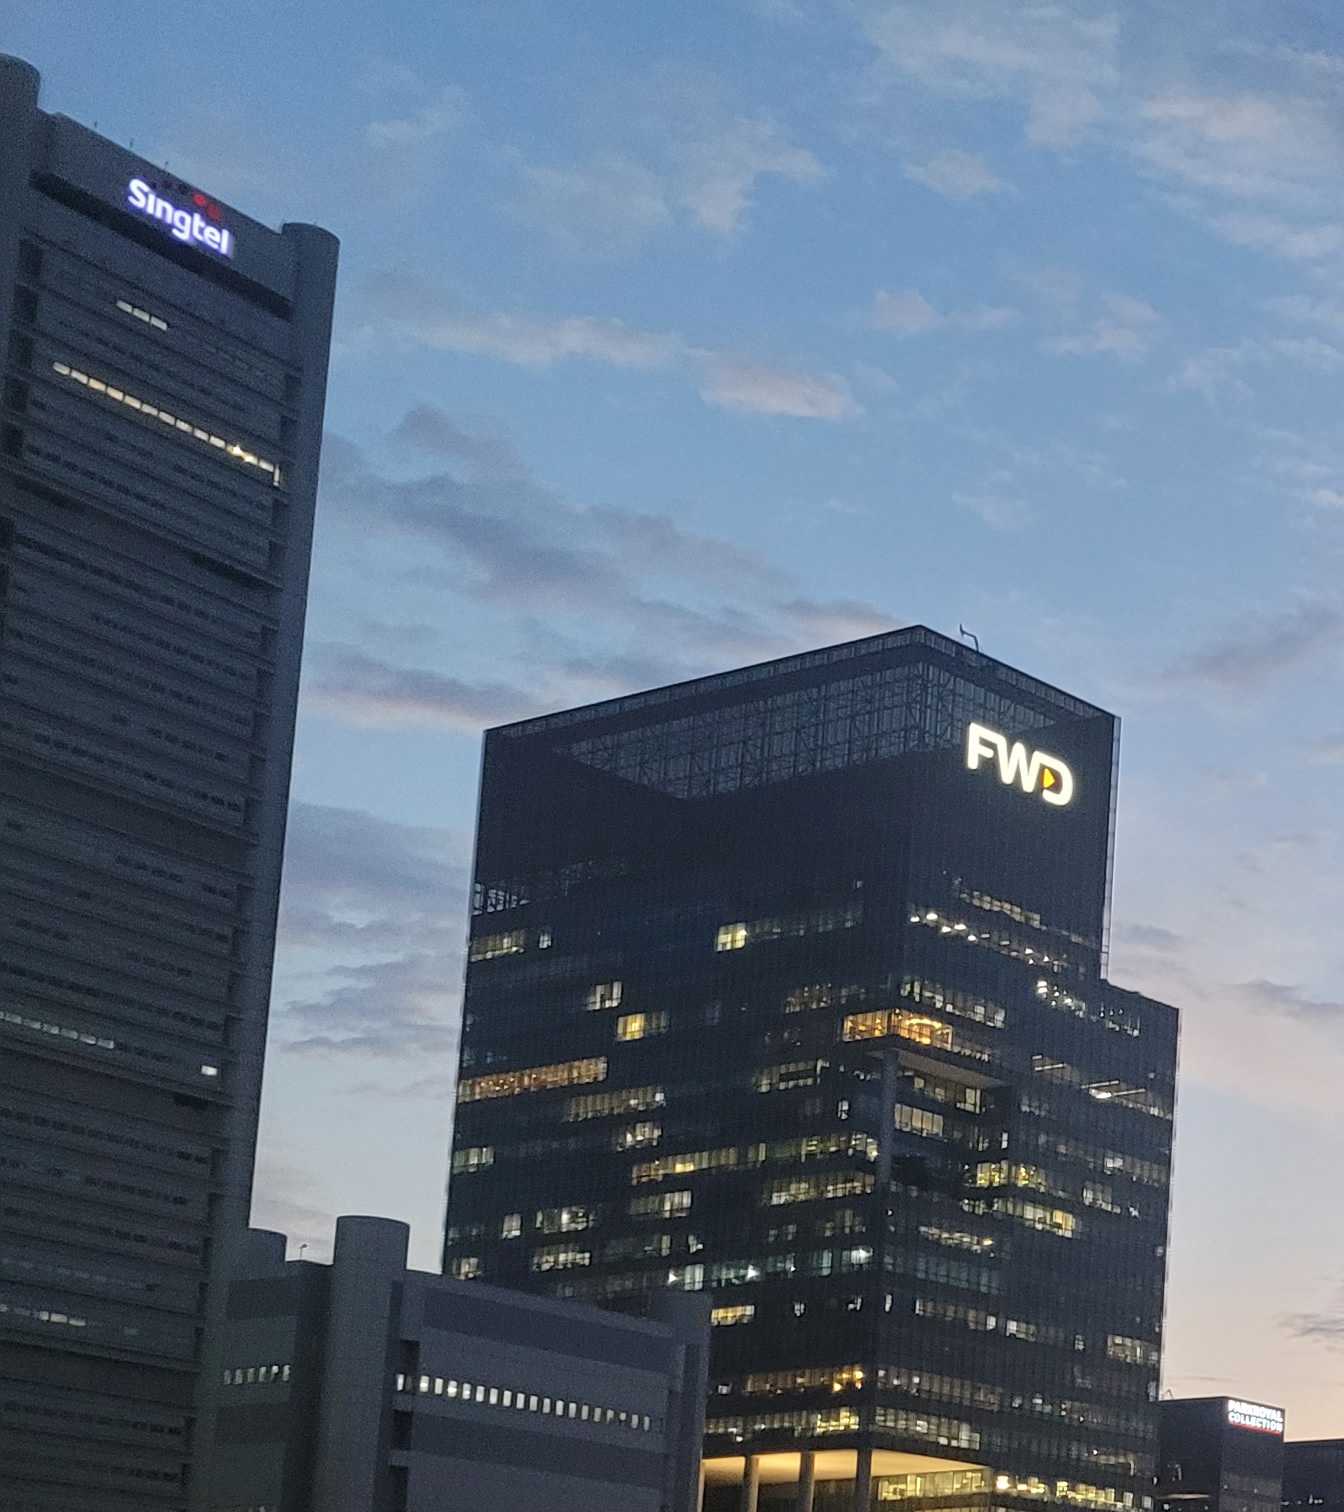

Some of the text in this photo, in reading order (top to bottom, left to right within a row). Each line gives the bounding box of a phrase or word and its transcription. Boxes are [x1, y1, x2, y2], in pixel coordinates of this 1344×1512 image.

[128, 178, 230, 255] Singtel
[967, 722, 1074, 806] FWD
[1228, 1400, 1283, 1422] PARKROYAL
[1228, 1411, 1283, 1432] COLLECTION
